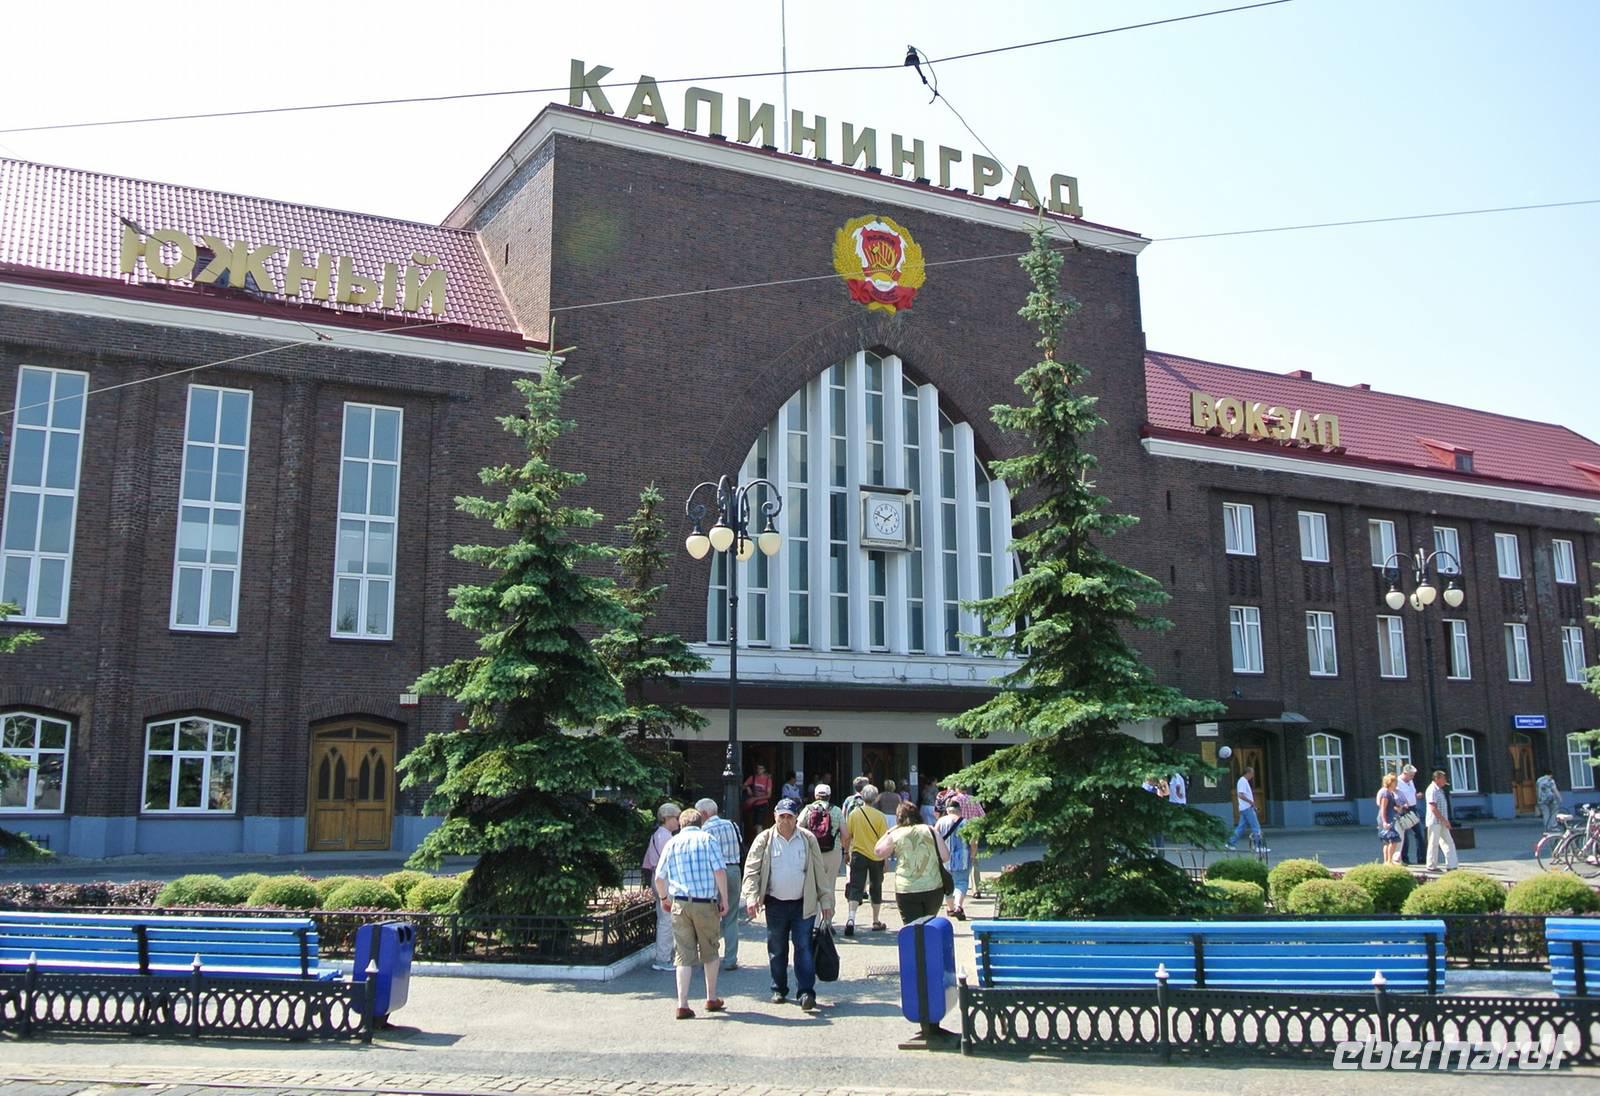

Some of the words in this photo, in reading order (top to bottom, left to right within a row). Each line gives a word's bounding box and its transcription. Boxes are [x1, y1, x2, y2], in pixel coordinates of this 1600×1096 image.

[569, 58, 1083, 217] КАЛИНИНГРАД
[120, 224, 447, 316] ЮЖНЫЙ
[1190, 391, 1341, 447] ВОКЗАЛ
